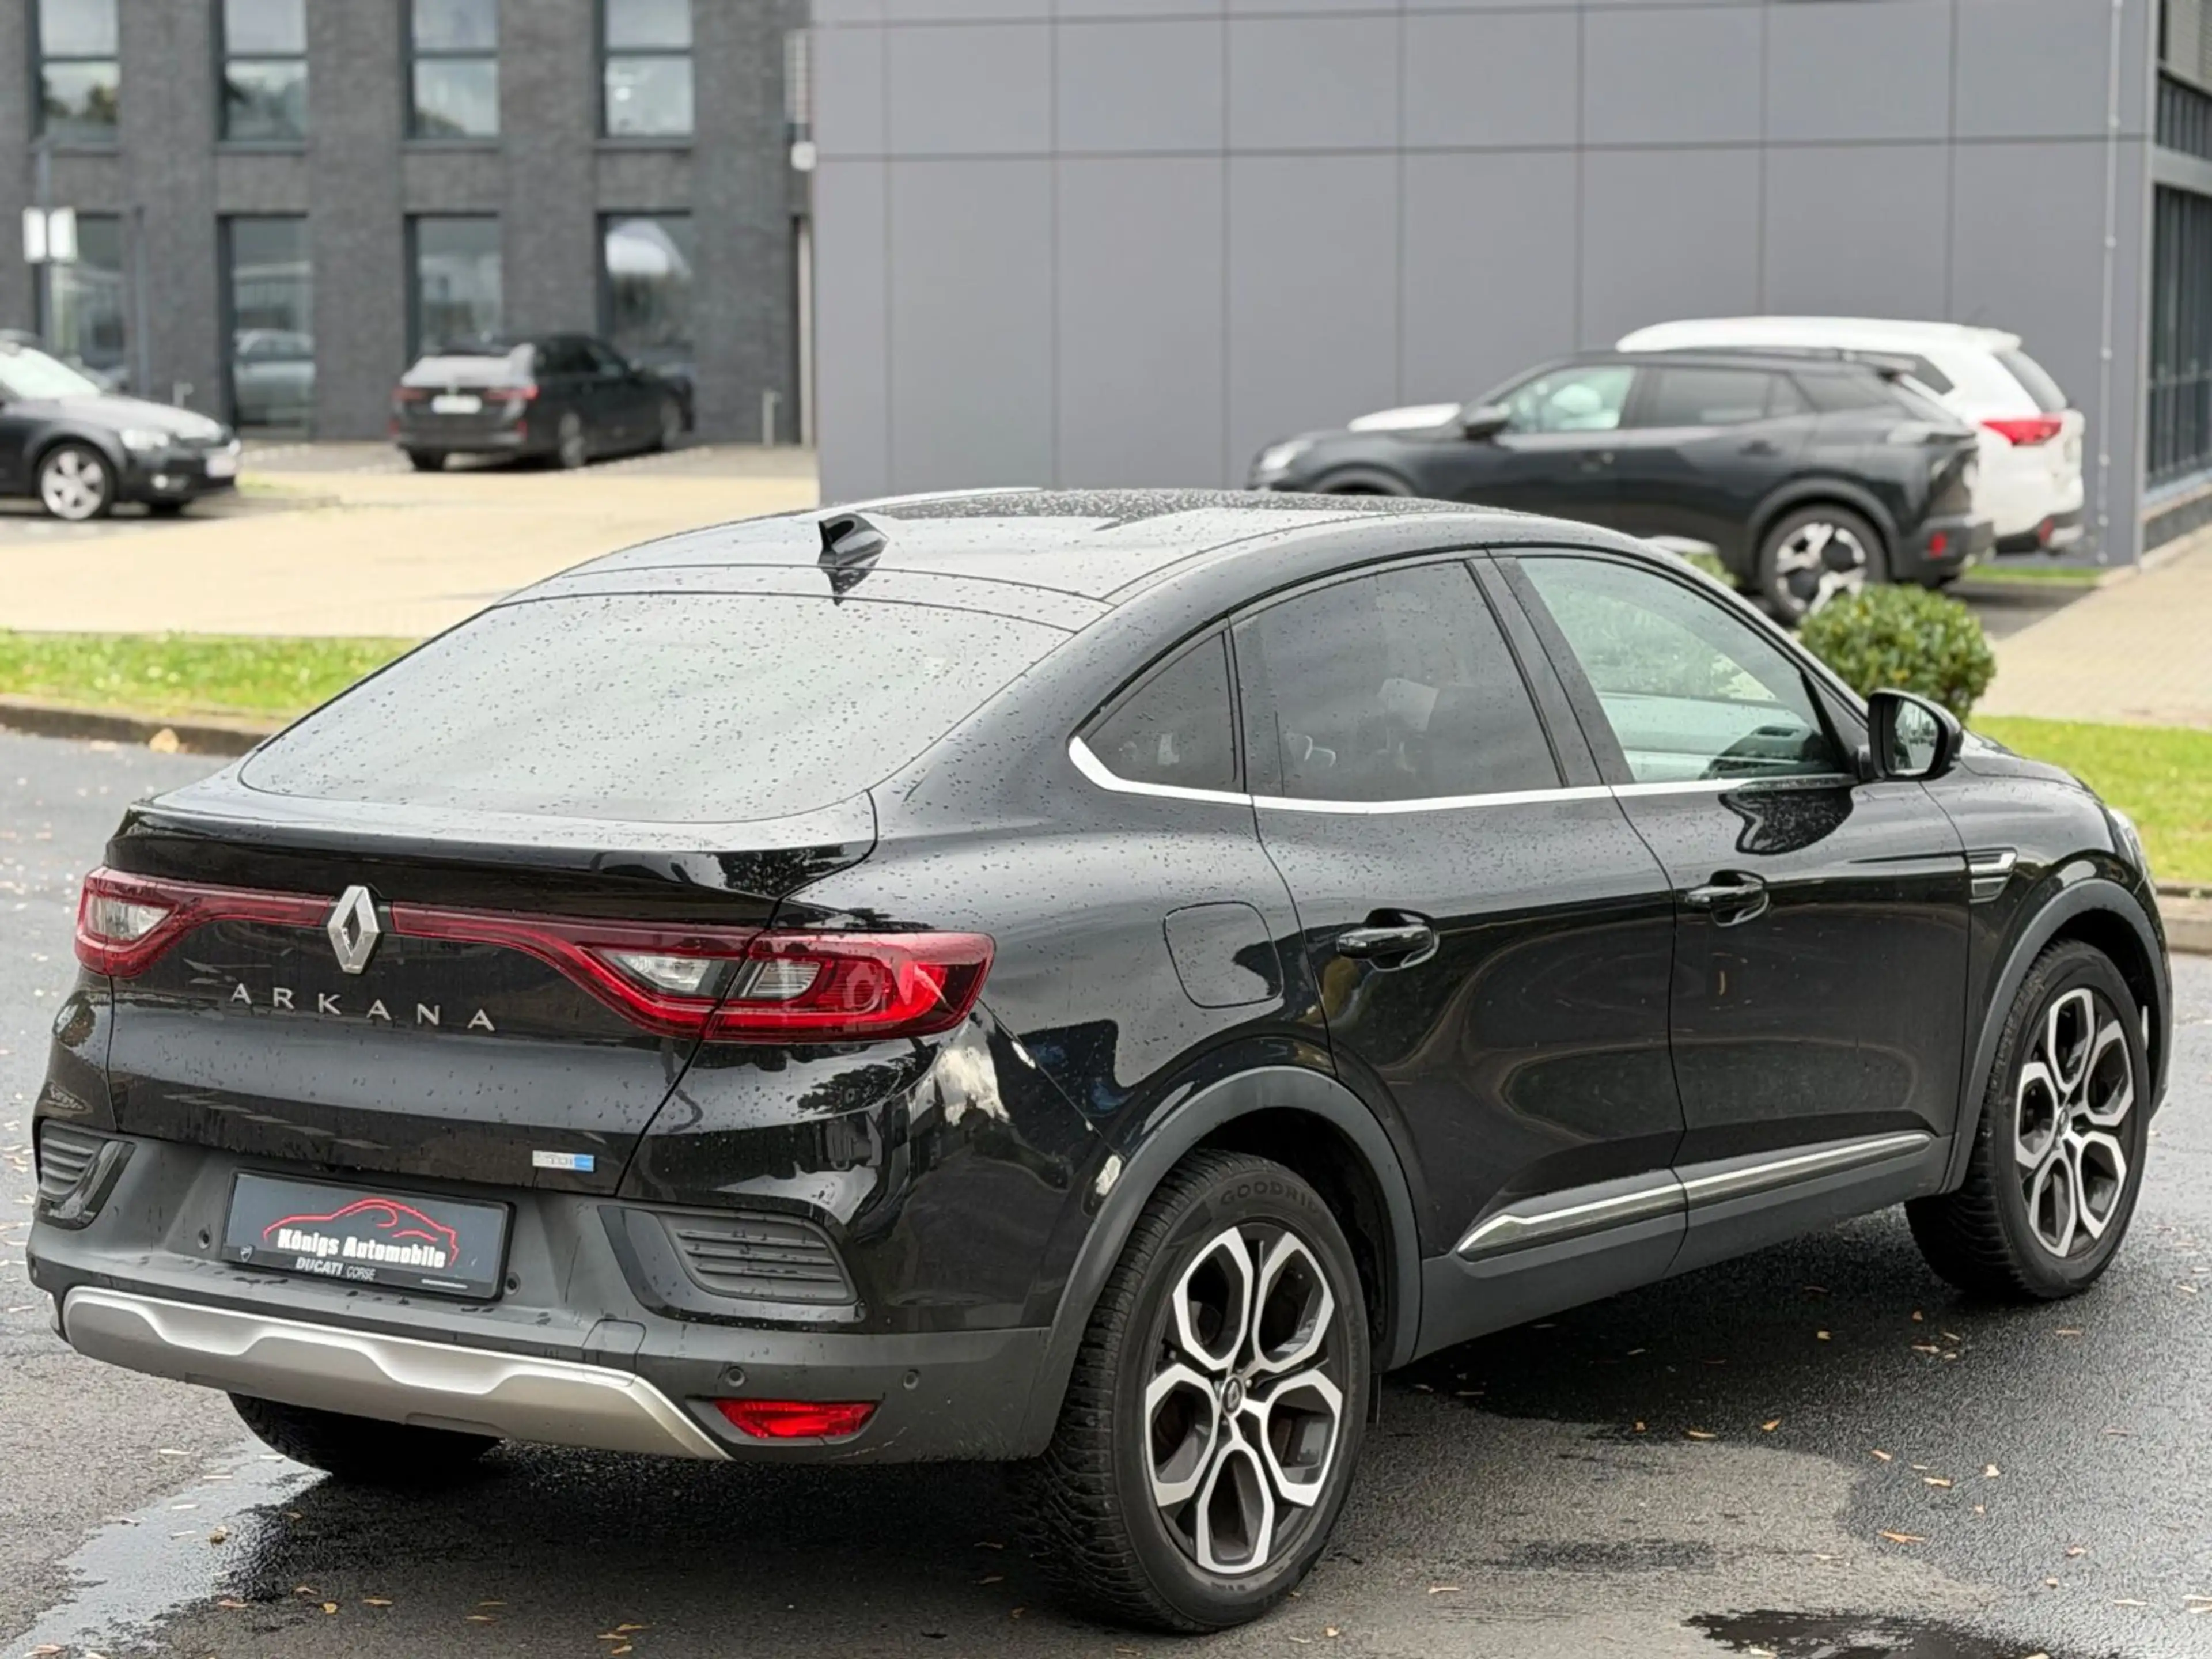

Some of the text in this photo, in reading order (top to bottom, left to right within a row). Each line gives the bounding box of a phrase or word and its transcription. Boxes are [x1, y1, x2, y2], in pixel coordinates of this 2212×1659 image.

[232, 983, 495, 1032] ARKANA
[278, 1228, 446, 1268] Königs Automobile
[296, 1257, 376, 1281] DUCATI CORSE
